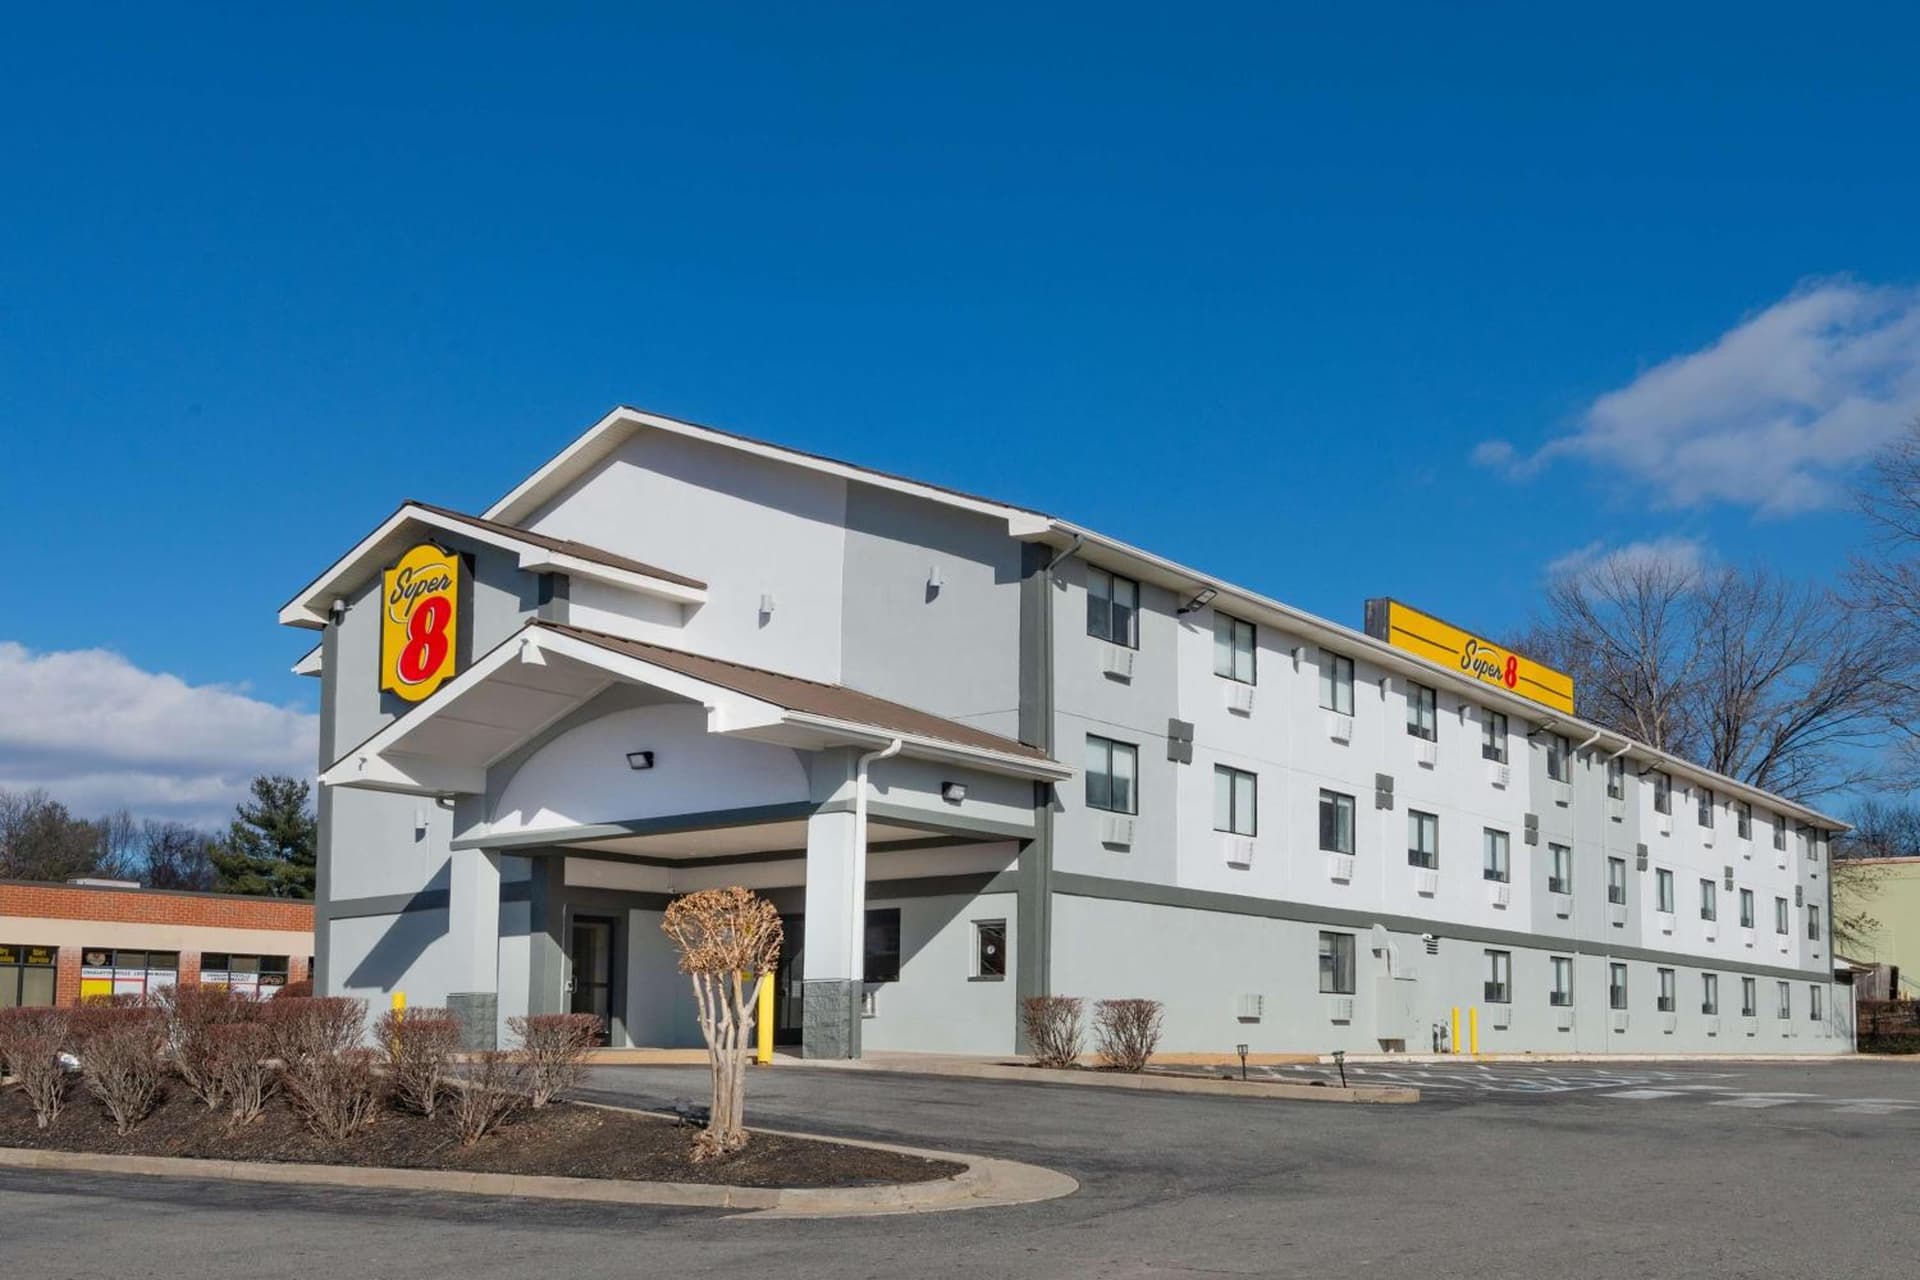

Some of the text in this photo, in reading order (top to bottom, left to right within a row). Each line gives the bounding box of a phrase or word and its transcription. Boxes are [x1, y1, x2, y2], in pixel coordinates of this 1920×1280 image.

[390, 566, 452, 617] Super
[396, 595, 452, 686] 8
[1460, 639, 1519, 689] Super 8
